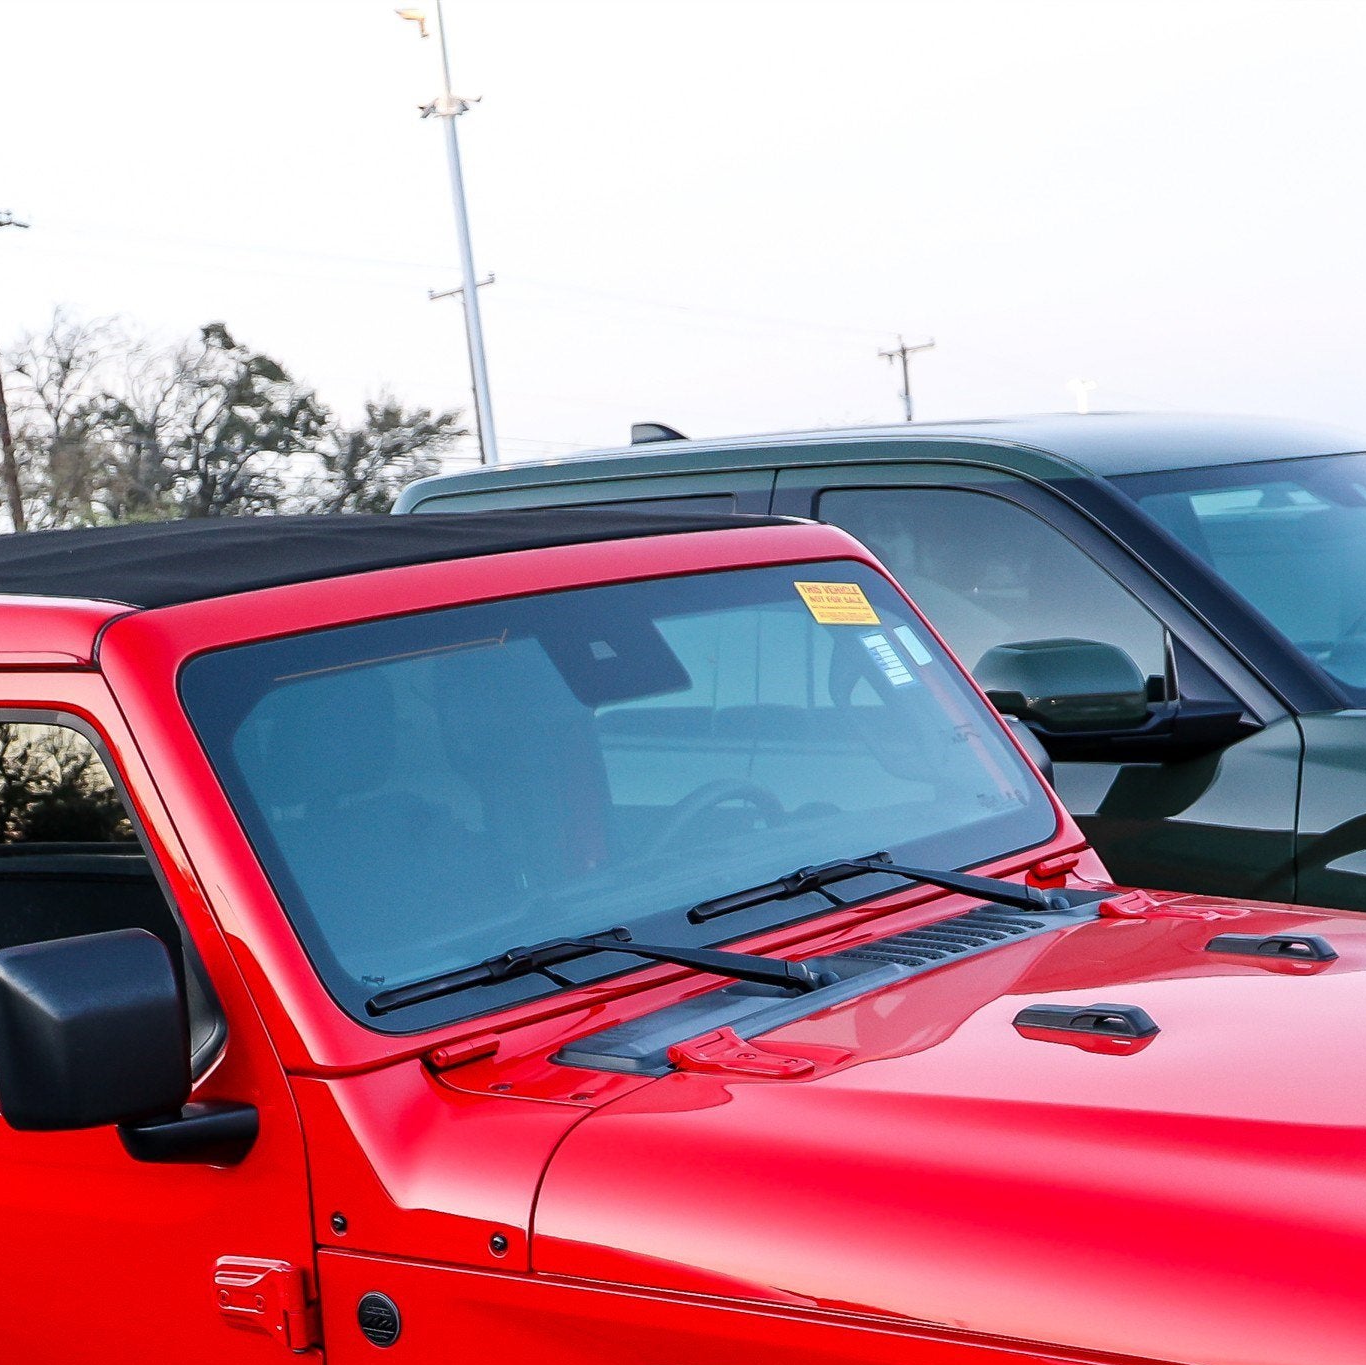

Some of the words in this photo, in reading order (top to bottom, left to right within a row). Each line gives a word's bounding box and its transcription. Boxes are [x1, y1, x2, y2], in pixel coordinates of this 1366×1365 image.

[800, 585, 822, 594] THIS
[823, 586, 860, 595] VEHICLE
[809, 595, 825, 603] NOT
[826, 595, 843, 603] FOR
[843, 596, 864, 604] SALE
